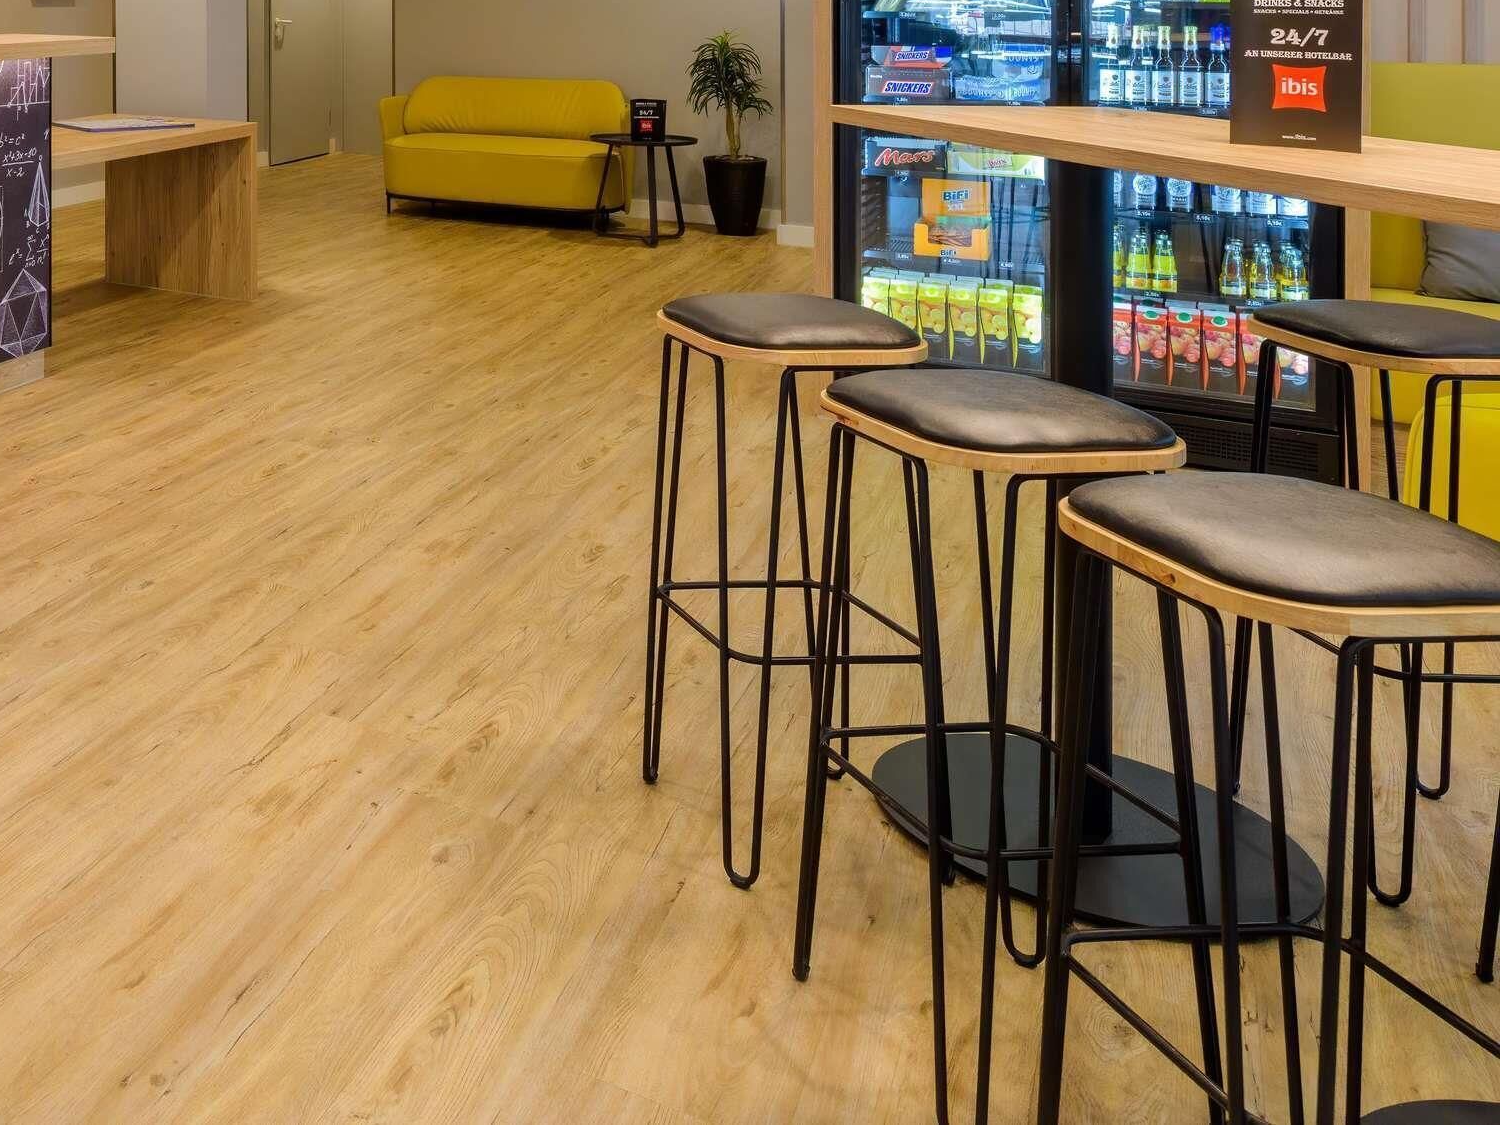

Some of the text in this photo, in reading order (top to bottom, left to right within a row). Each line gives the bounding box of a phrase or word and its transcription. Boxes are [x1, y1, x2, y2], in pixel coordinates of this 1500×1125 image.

[1293, 0, 1303, 8] &
[1304, 0, 1345, 8] SNACKS
[1270, 27, 1329, 47] 24/7
[895, 51, 929, 61] SNICKERS
[1243, 49, 1352, 61] AN UNSERER HOTELBAR
[884, 81, 932, 94] SNICKERS
[1280, 76, 1318, 96] ibis
[874, 147, 936, 166] Mars
[943, 189, 969, 201] BiFi
